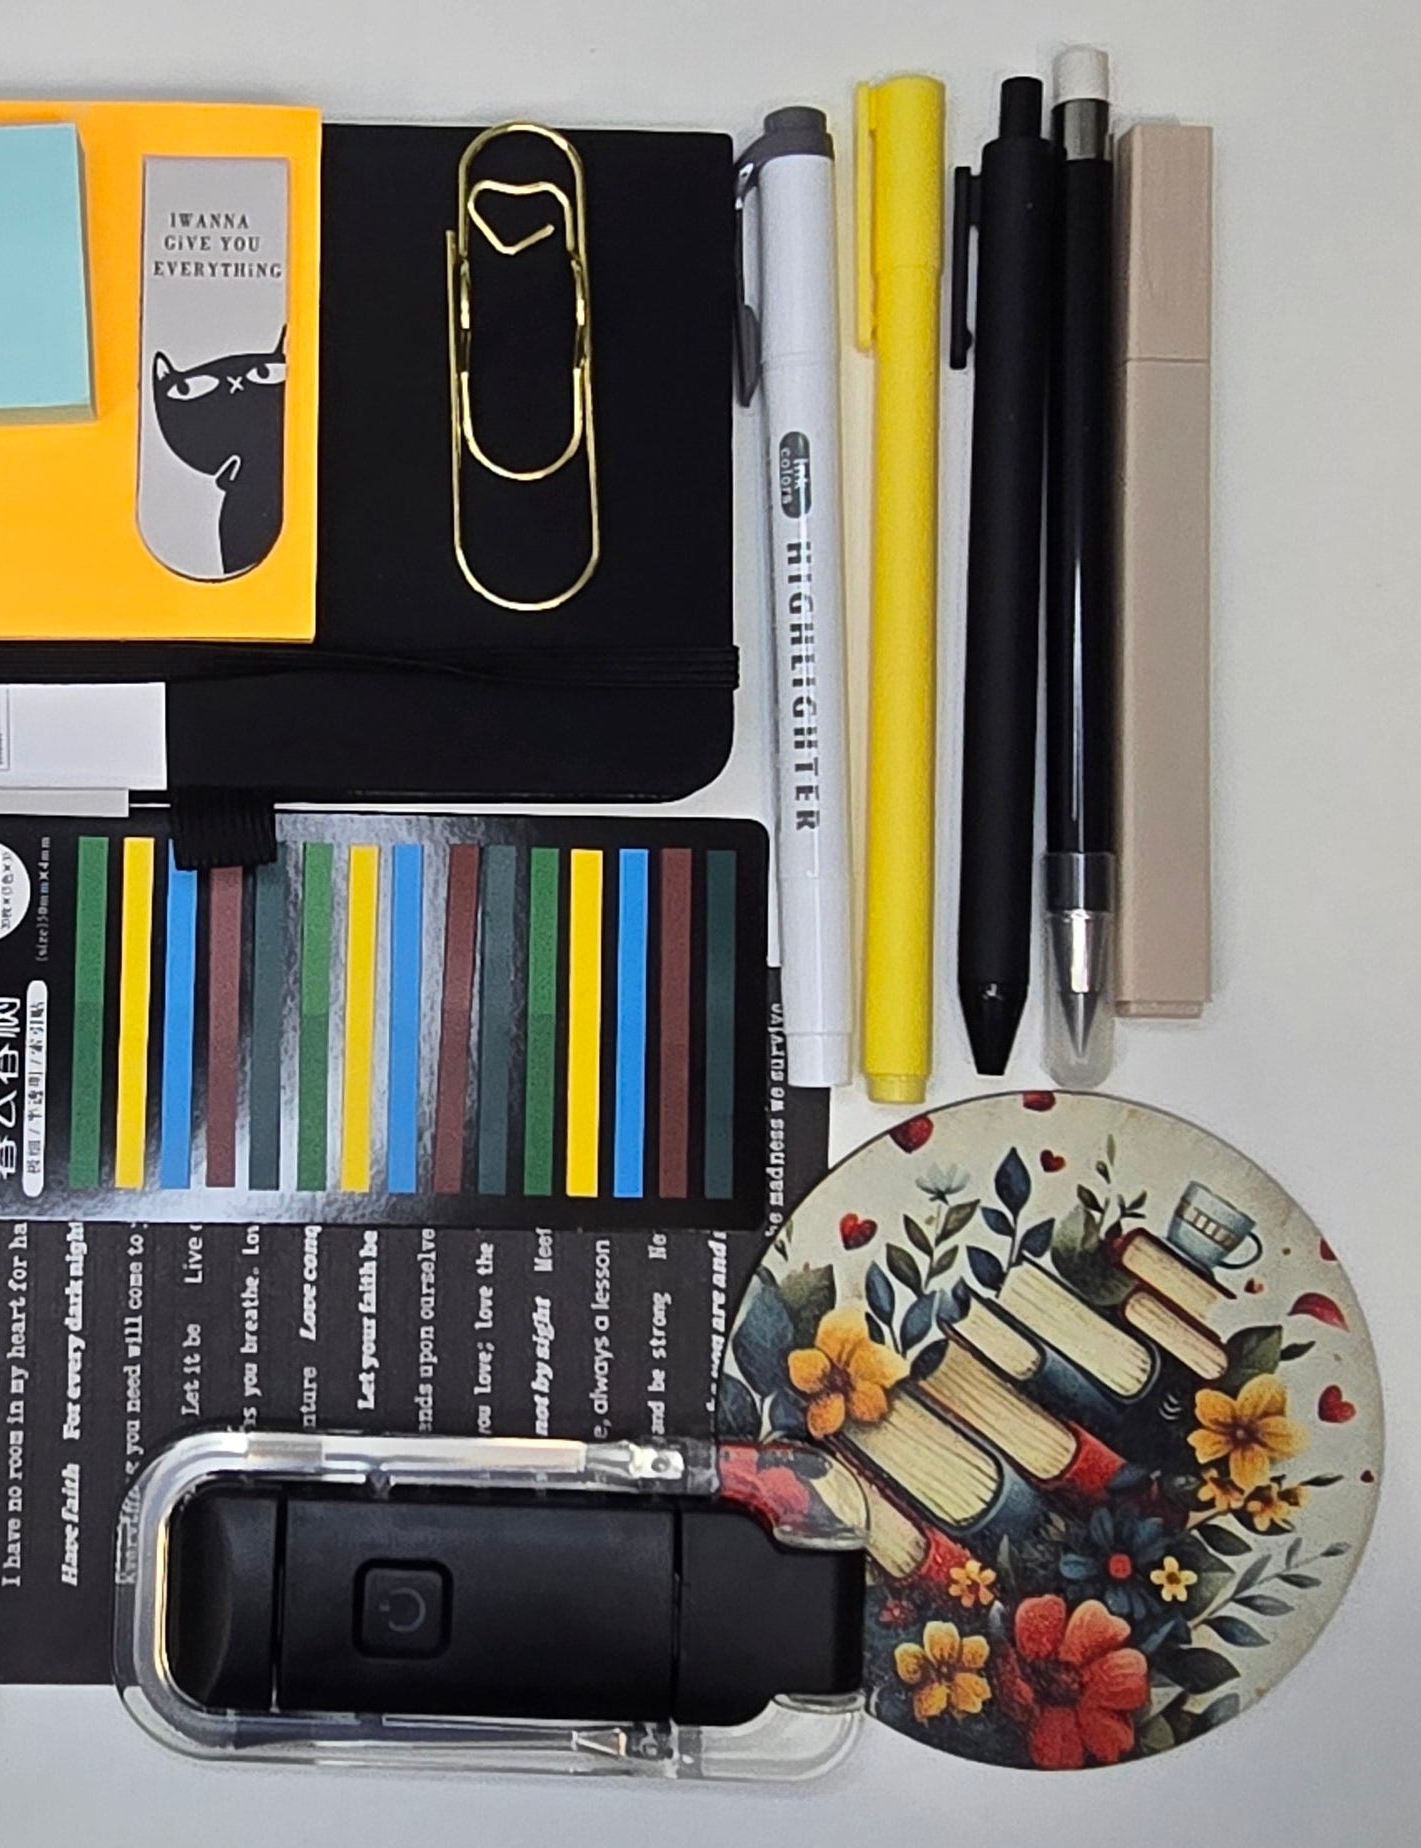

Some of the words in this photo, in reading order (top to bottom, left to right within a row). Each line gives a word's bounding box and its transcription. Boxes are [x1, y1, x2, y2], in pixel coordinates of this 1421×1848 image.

[220, 236, 260, 252] YOU
[787, 542, 820, 831] HIGHLIGHTER
[768, 1087, 785, 1112] we
[766, 1118, 785, 1207] madness
[127, 1235, 144, 1256] to
[183, 1237, 203, 1283] Live
[359, 1230, 378, 1257] be
[475, 1242, 493, 1276] the
[708, 1240, 726, 1288] and
[8, 1255, 27, 1292] for
[128, 1262, 143, 1310] come
[358, 1261, 377, 1314] faith
[591, 1239, 611, 1310] lesson
[64, 1279, 83, 1331] dark
[240, 1266, 260, 1353] breathe.
[299, 1283, 317, 1340] Love
[474, 1286, 493, 1329] love
[593, 1315, 610, 1331] a
[649, 1291, 672, 1359] strong
[712, 1290, 726, 1332] are
[6, 1297, 27, 1358] heart
[125, 1316, 142, 1357] will
[183, 1323, 201, 1346] be
[360, 1316, 379, 1369] your
[532, 1296, 554, 1360] sight
[66, 1335, 86, 1399] every
[183, 1354, 200, 1374] it
[418, 1325, 438, 1378] upon
[474, 1342, 494, 1395] love;
[10, 1366, 28, 1394] my
[124, 1365, 141, 1412] need
[243, 1362, 262, 1397] you
[357, 1372, 375, 1410] Let
[531, 1361, 553, 1393] by
[590, 1336, 614, 1414] always
[649, 1369, 666, 1392] be
[7, 1400, 24, 1424] in
[181, 1380, 200, 1415] Let
[533, 1394, 550, 1437] not
[648, 1401, 665, 1435] and
[63, 1402, 80, 1440] For
[128, 1420, 143, 1455] you
[8, 1431, 24, 1480] room
[8, 1486, 22, 1512] no
[62, 1463, 80, 1523] faith
[3, 1519, 21, 1568] have
[61, 1525, 79, 1586] Have
[2, 1575, 21, 1587] I
